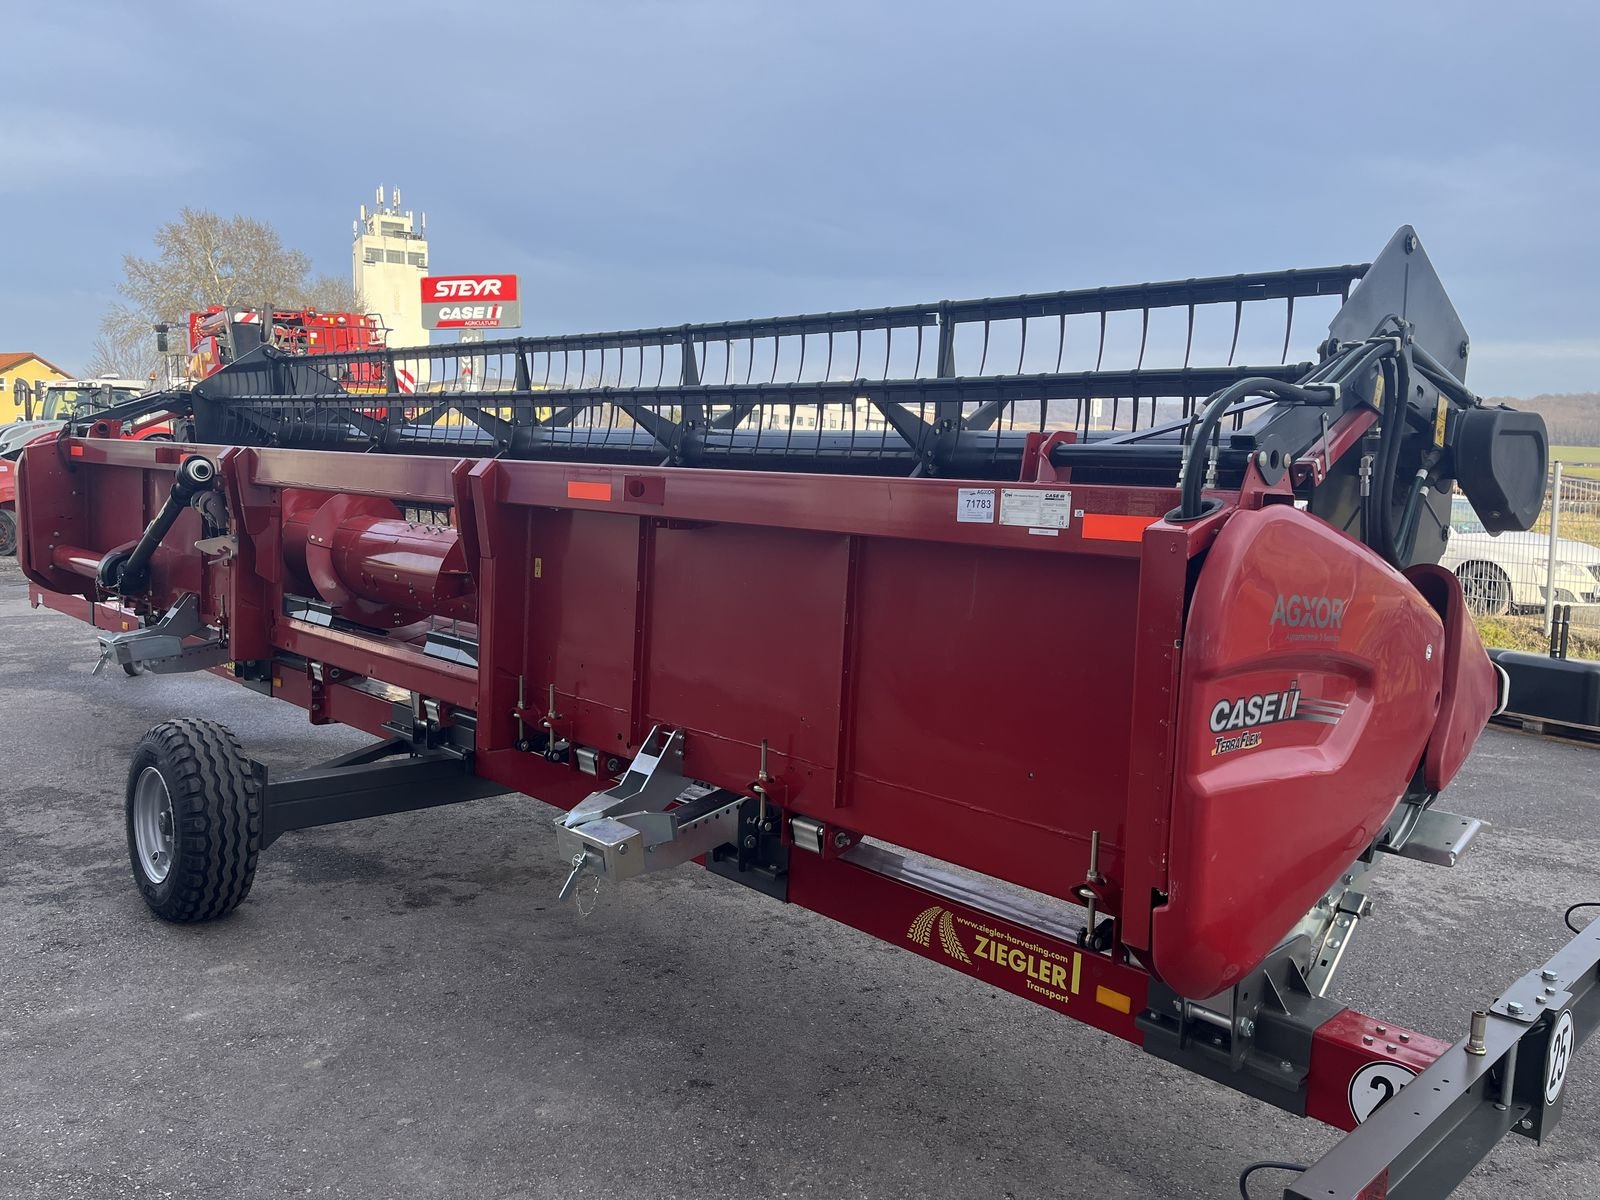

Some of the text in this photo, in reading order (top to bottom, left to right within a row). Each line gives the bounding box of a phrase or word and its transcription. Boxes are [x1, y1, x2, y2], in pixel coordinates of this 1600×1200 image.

[433, 279, 502, 297] STEYR
[439, 306, 485, 320] CASE
[966, 499, 991, 509] 71783
[1270, 594, 1345, 629] AGXOR
[1210, 694, 1279, 732] CASE
[956, 916, 1068, 964] www.ziegler-harvesting.com
[973, 935, 1067, 990] ZIEGLER
[1026, 979, 1069, 1004] Transport
[1550, 1024, 1570, 1087] 25
[1366, 1075, 1405, 1119] 2
